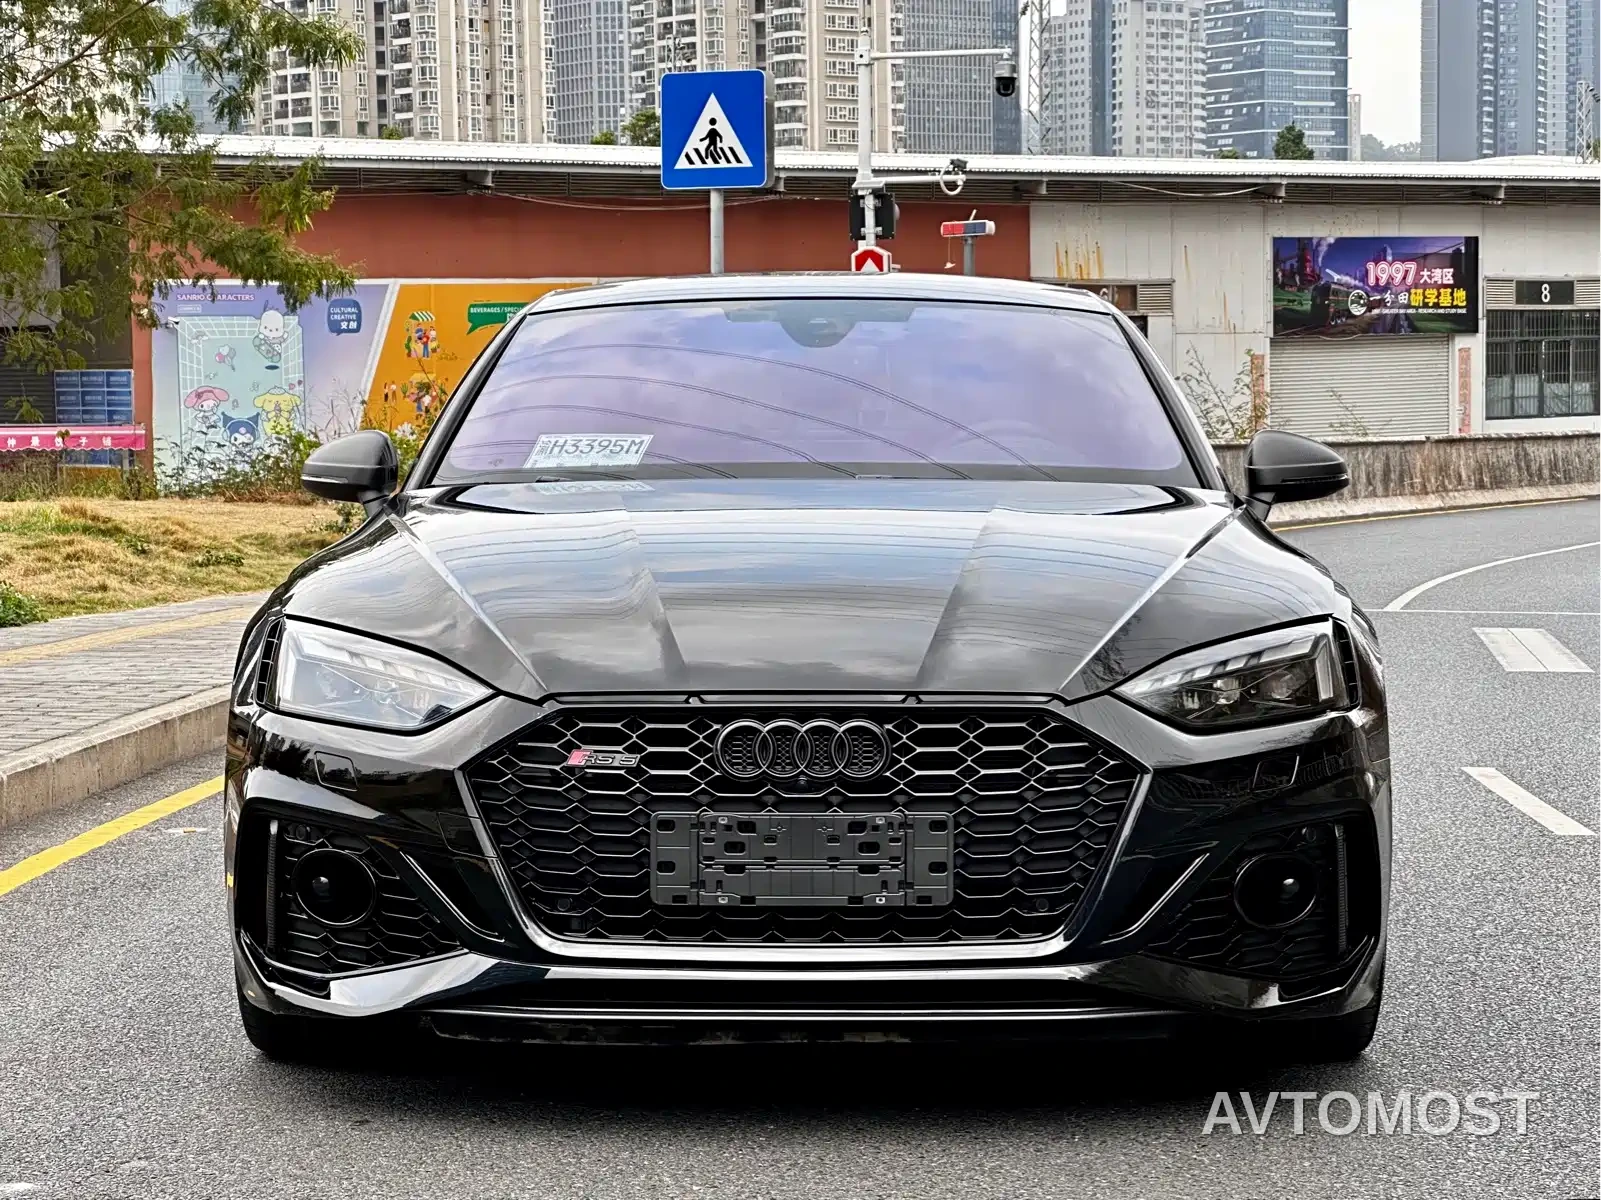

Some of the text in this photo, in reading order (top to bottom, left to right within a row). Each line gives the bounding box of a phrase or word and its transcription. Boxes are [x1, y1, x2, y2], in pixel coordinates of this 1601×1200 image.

[1366, 261, 1454, 286] 1997 大湾区
[1410, 288, 1467, 306] 研学基地
[1541, 283, 1550, 303] 8
[340, 321, 357, 329] 文创
